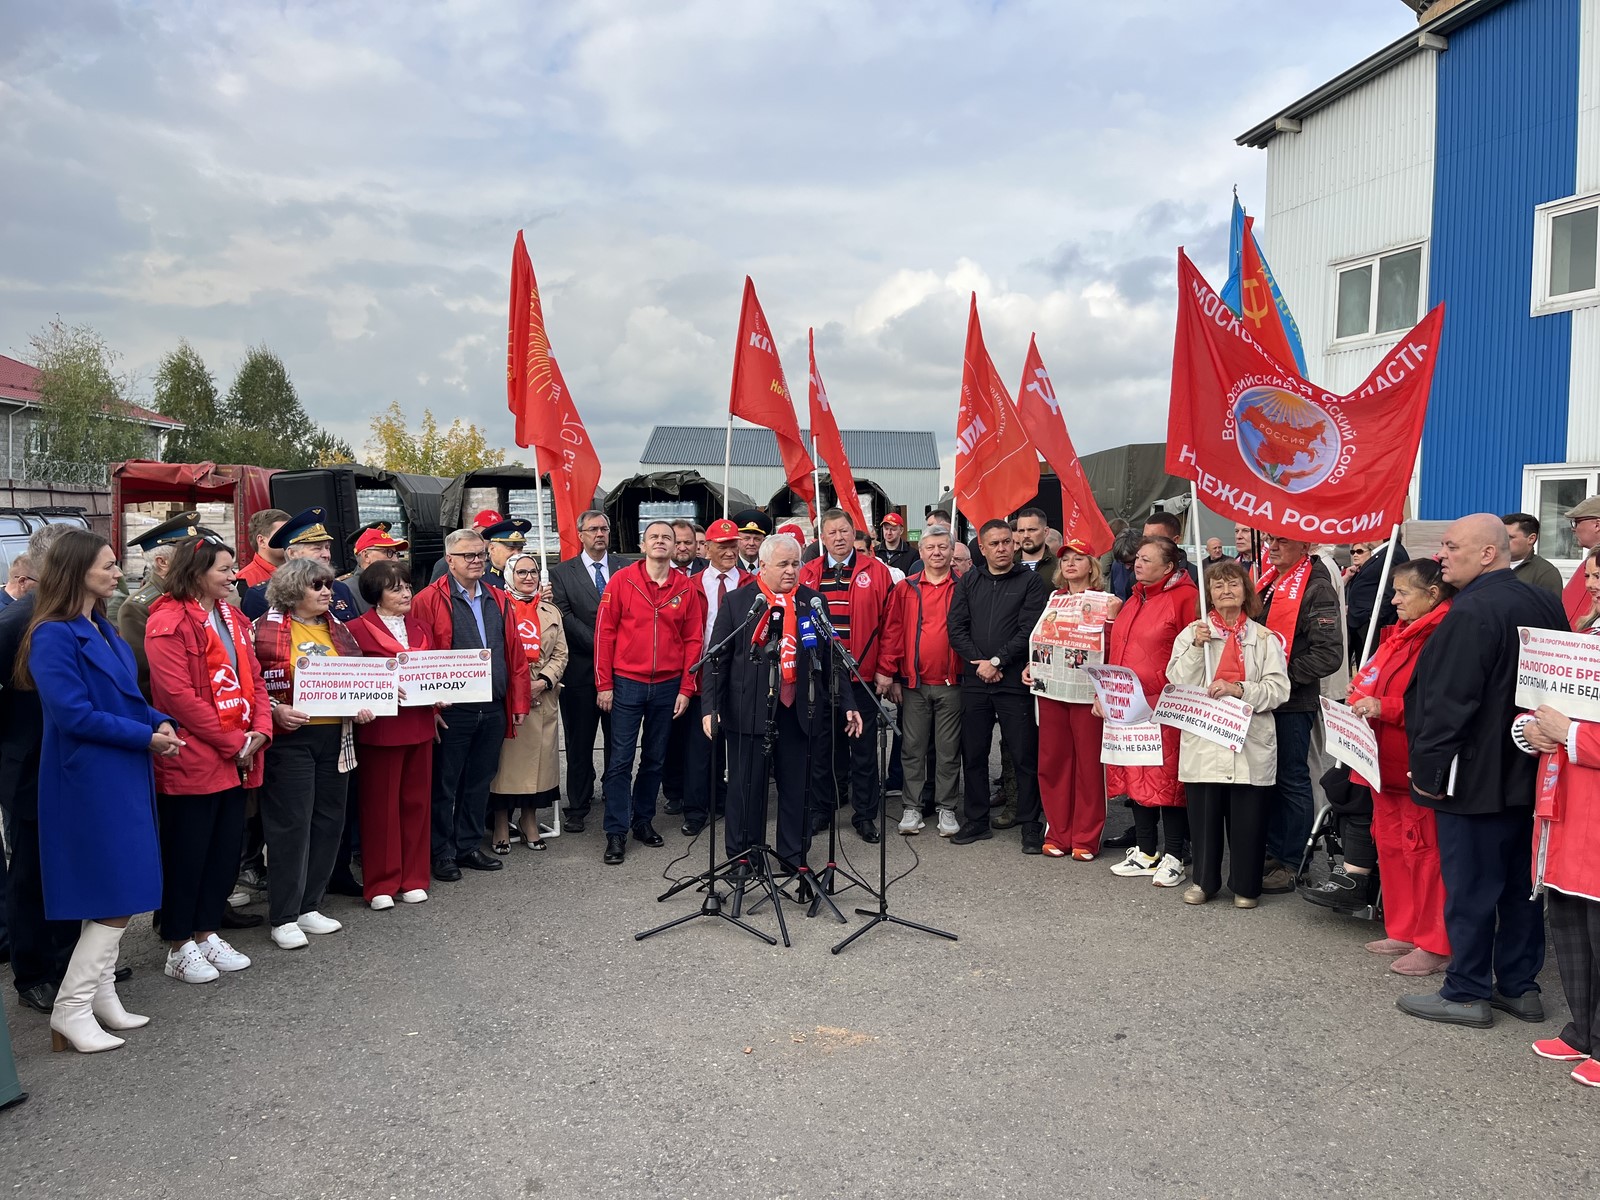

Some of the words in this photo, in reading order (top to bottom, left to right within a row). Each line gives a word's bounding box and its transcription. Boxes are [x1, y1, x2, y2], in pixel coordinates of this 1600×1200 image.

[1260, 422, 1305, 446] РОССИЯ
[1178, 443, 1274, 521] НЕЖДА
[1281, 508, 1385, 536] РОССИИ
[263, 668, 285, 679] ДЕТИ
[1520, 659, 1573, 678] НАЛОГОВОЕ
[398, 671, 448, 682] БОГАТСТВА
[449, 670, 487, 679] РОССИИ
[265, 679, 291, 691] ОЙНЫ
[299, 680, 352, 689] ОСТАНОВИМ
[353, 680, 374, 689] РОСТ
[375, 680, 395, 690] ЦЕН,
[420, 681, 467, 691] НАРОДУ
[1519, 674, 1549, 692] БОГАТЫМ,
[1550, 681, 1557, 692] А
[1560, 682, 1575, 695] НЕ
[1577, 685, 1600, 701] БЕД
[299, 691, 338, 702] ДОЛГОВ
[339, 691, 347, 700] И
[348, 691, 394, 700] ТАРИФОВ
[218, 697, 244, 710] КПР
[1159, 700, 1203, 717] ГОРОДАМ
[1203, 709, 1211, 719] И
[1211, 712, 1242, 732] СЕЛАМ
[1155, 709, 1185, 722] РАБОЧИЕ
[1185, 715, 1207, 730] МЕСТА
[1207, 723, 1213, 731] И
[1212, 725, 1245, 745] РАЗВИТИЕ
[1122, 734, 1132, 742] НЕ
[1133, 734, 1161, 742] ТОВАР,
[1125, 744, 1135, 752] НЕ
[1136, 744, 1162, 752] БАЗАР
